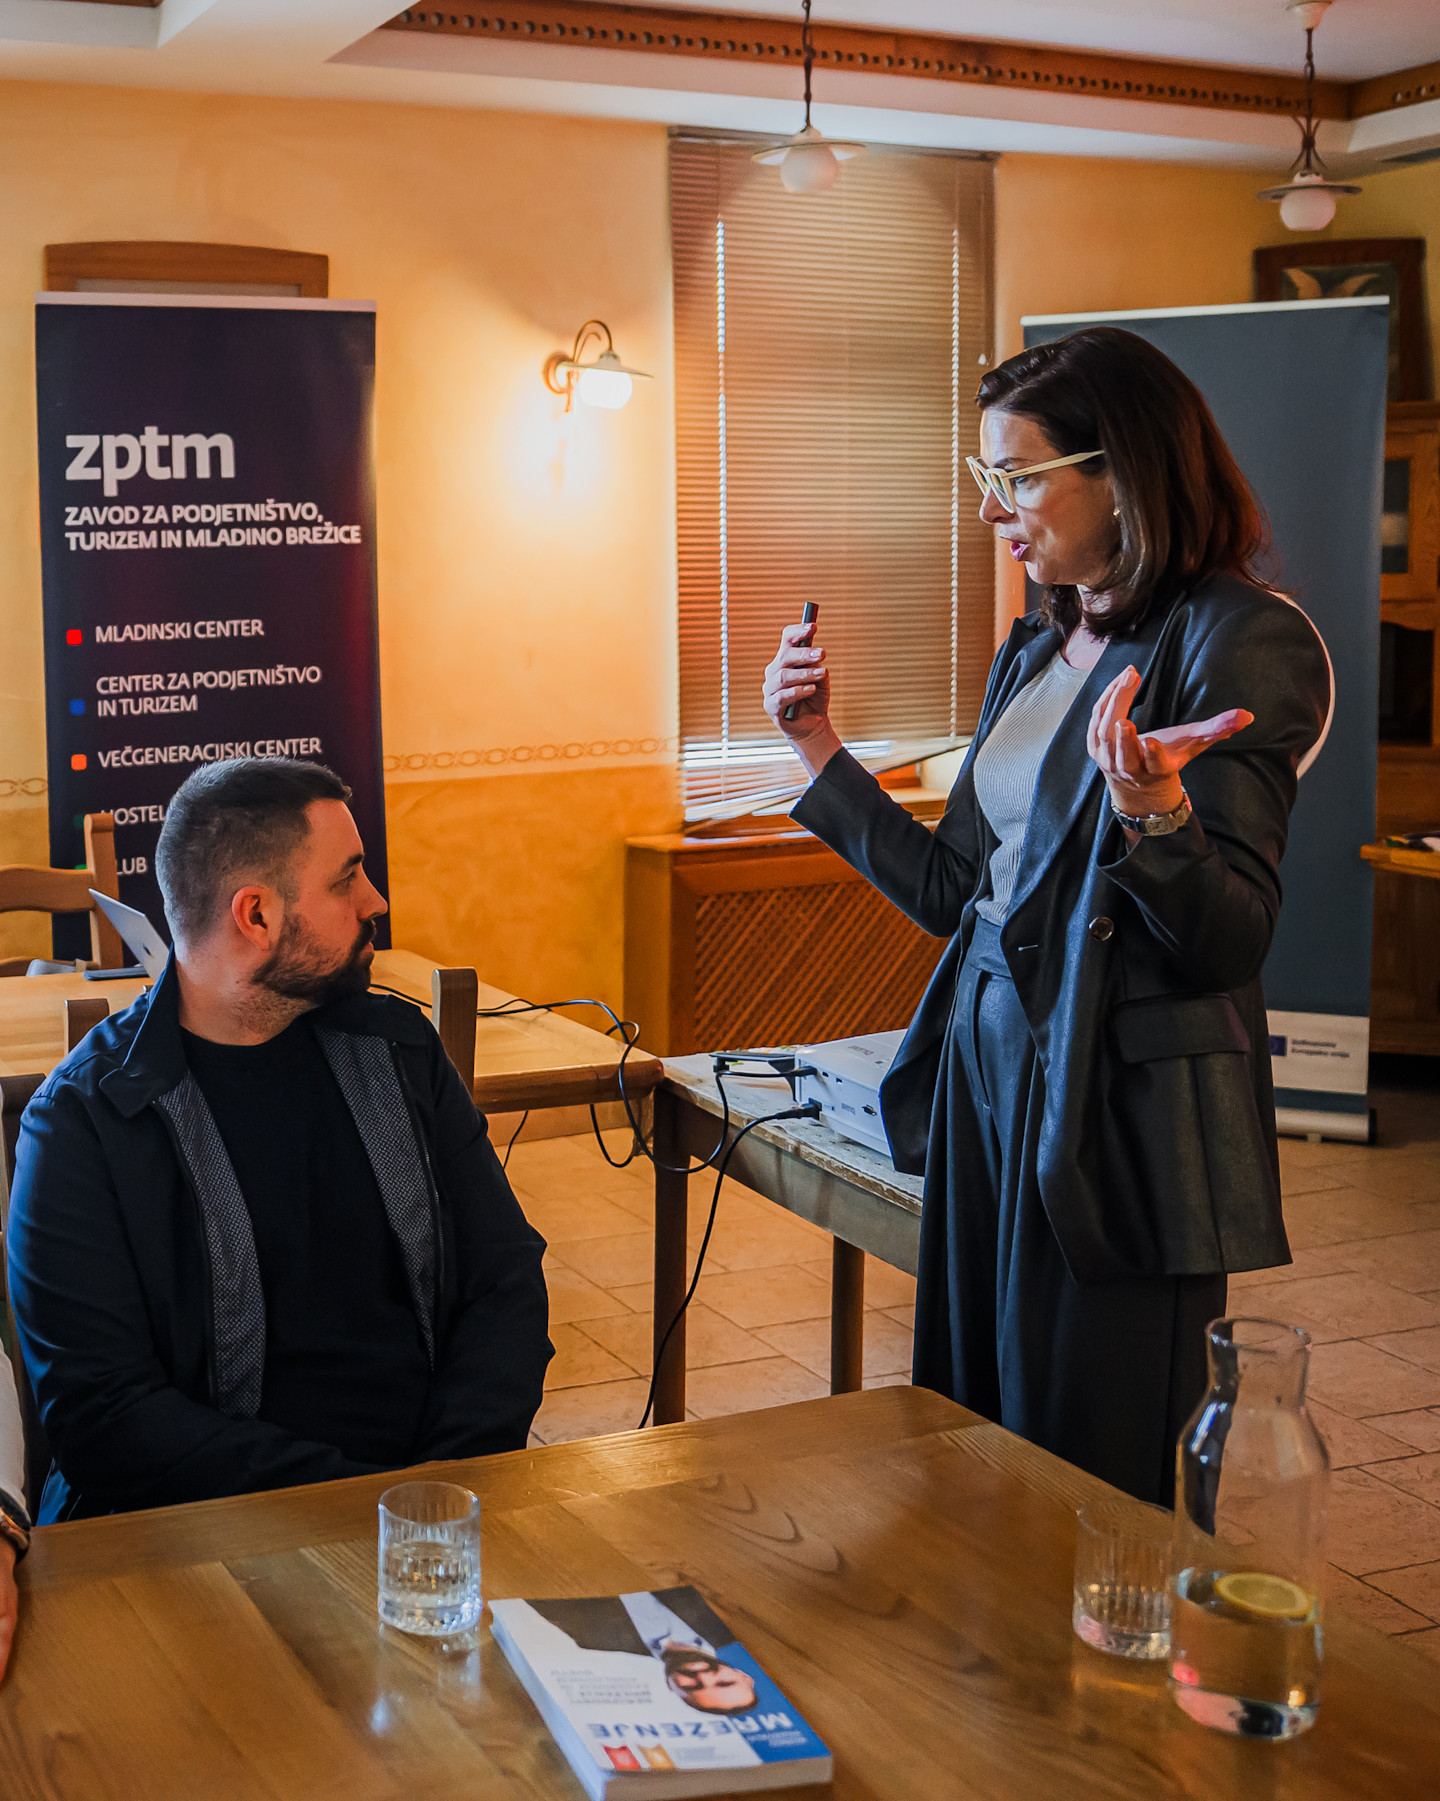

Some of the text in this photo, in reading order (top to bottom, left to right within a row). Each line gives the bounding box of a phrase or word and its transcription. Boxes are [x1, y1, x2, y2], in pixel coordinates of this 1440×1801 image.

[65, 426, 235, 497] zptm
[64, 499, 324, 526] ZAVOD ZA PODJETNIŠTVO,
[64, 521, 362, 551] TURIZEM IN MLADINO BREŽICE
[95, 619, 264, 643] MLADINSKI CENTER
[96, 665, 321, 694] CENTER ZA PODJETNIŠTVO
[97, 695, 198, 717] IN TURIZEM
[98, 737, 322, 767] VEČGENERACIJSKI CENTER
[101, 804, 165, 825] OSTEL
